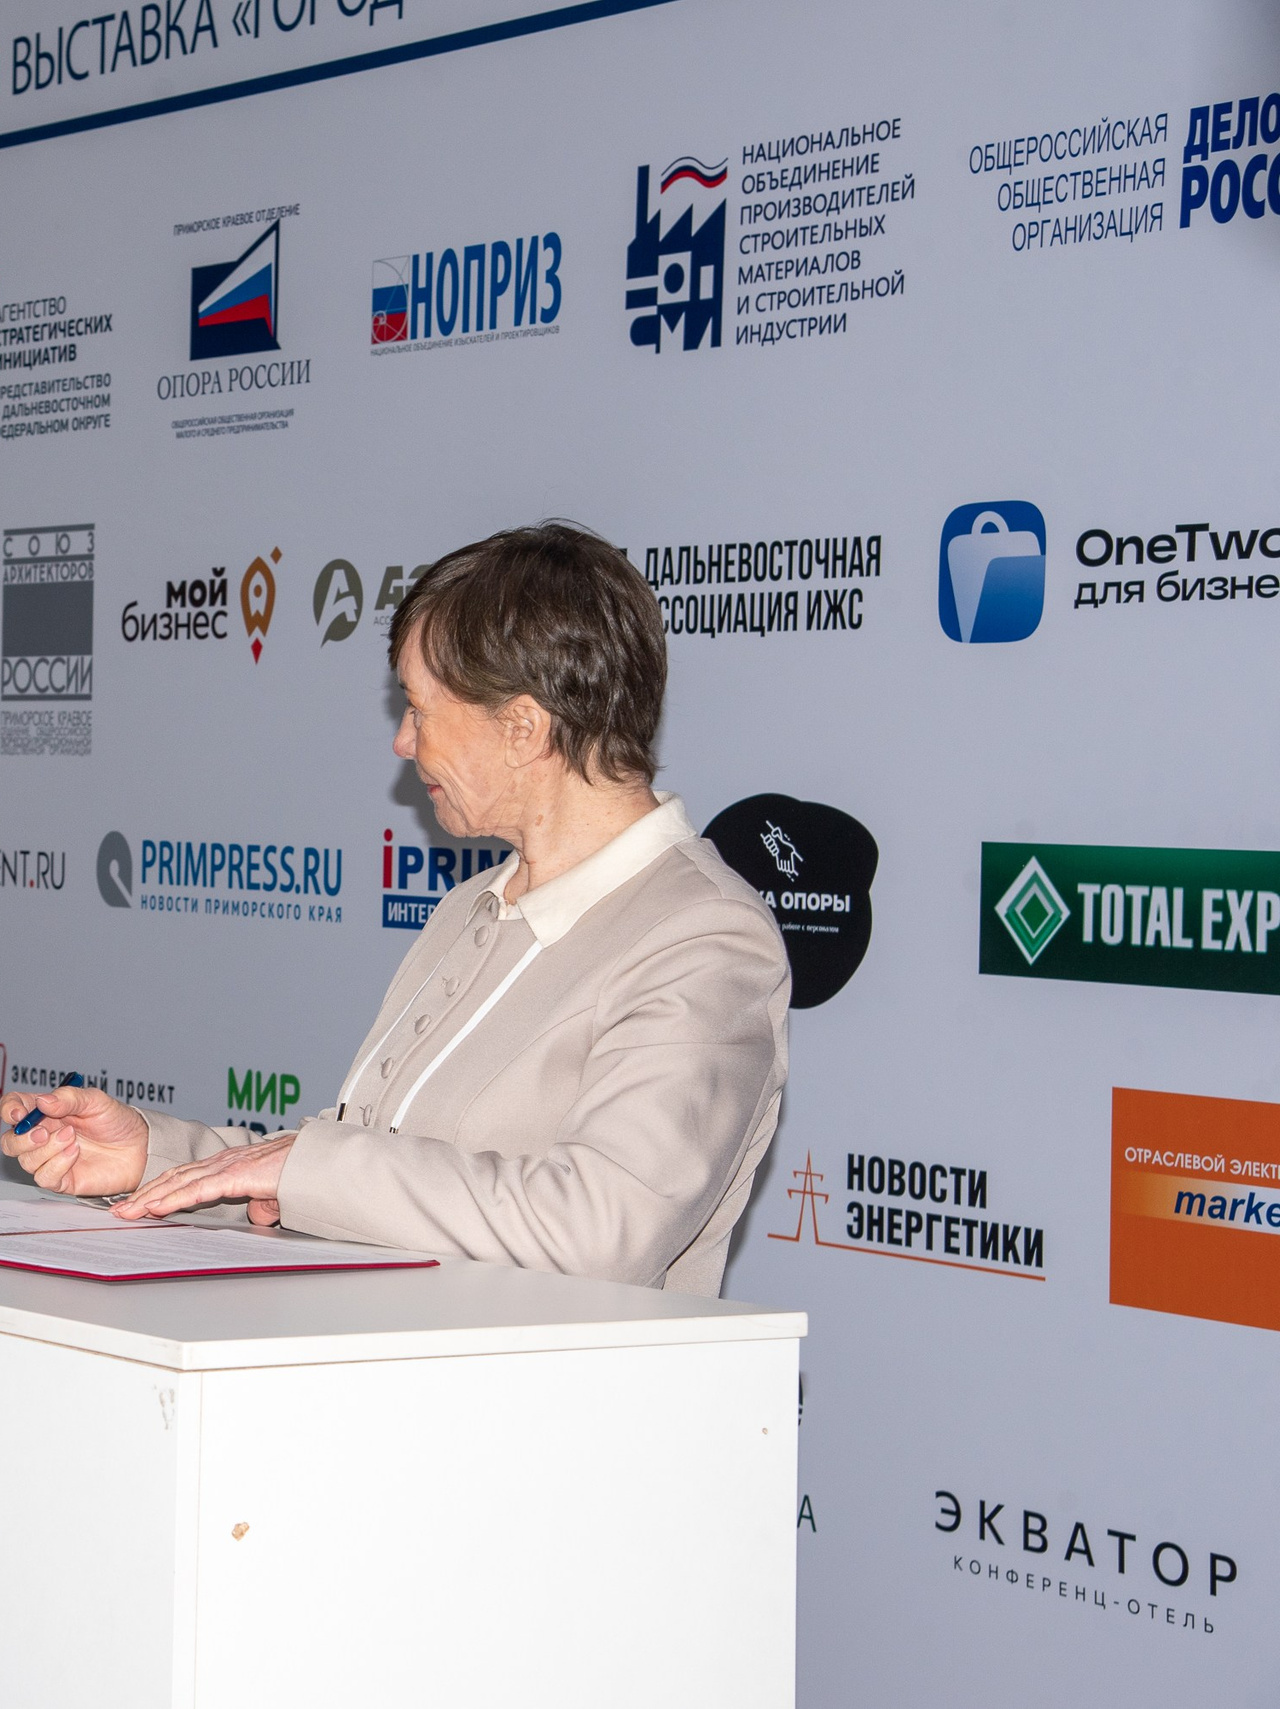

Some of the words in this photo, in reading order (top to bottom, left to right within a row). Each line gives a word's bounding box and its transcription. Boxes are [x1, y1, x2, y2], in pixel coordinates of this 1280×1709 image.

[12, 0, 219, 95] ВЫСТАВКА
[742, 118, 902, 165] НАЦИОНАЛЬНОЕ
[969, 112, 1168, 175] ОБЩЕРОССИЙСКАЯ
[741, 153, 880, 194] ОБЪЕДИНЕНИЕ
[997, 158, 1166, 213] ОБЩЕСТВЕННАЯ
[740, 173, 916, 225] ПРОИЗВОДИТЕЛЕЙ
[739, 214, 886, 254] СТРОИТЕЛЬНЫХ
[1011, 202, 1163, 251] ОРГАНИЗАЦИЯ
[411, 232, 562, 340] НОПРИЗ
[738, 250, 862, 285] МАТЕРИАЛОВ
[737, 295, 750, 315] И
[755, 269, 905, 312] СТРОИТЕЛЬНОЙ
[736, 312, 847, 346] ИНДУСТРИИ
[157, 370, 223, 400] ОПОРА
[228, 359, 311, 392] РОССИИ
[2, 393, 111, 421] ДАЛЬНЕВОСТОЧНОМ
[72, 413, 111, 432] ОКРУГЕ
[2, 531, 95, 558] СОЮЗ
[646, 535, 882, 591] ДАЛЬНЕВОСТОЧНАЯ
[1075, 523, 1280, 567] OneTwo
[2, 561, 94, 583] АРХИТЕКТОРОВ
[166, 567, 228, 608] мой
[1074, 580, 1145, 609] для
[1157, 569, 1280, 602] бизне
[122, 601, 228, 642] бизнес
[806, 588, 863, 631] ИЖС
[1, 655, 93, 695] РОССИИ
[141, 839, 342, 896] PRIMPRESS.RU
[140, 894, 199, 914] НОВОСТИ
[204, 898, 302, 921] ПРИМОРСКОГО
[308, 904, 343, 923] КРАЯ
[781, 891, 851, 913] ОПОРЫ
[1077, 882, 1194, 949] TOTAL
[1201, 887, 1280, 954] EXP
[116, 1078, 176, 1104] проект
[227, 1066, 301, 1116] МИР
[846, 1153, 987, 1209] НОВОСТИ
[1124, 1147, 1225, 1173] ОТРАСЛЕВОЙ
[1174, 1191, 1280, 1228] marke
[845, 1202, 1044, 1268] ЭНЕРГЕТИКИ
[934, 1490, 1238, 1597] ЭКВАТОР
[953, 1555, 1215, 1635] КОНФЕРЕНЦ-ОТЕЛЬ
